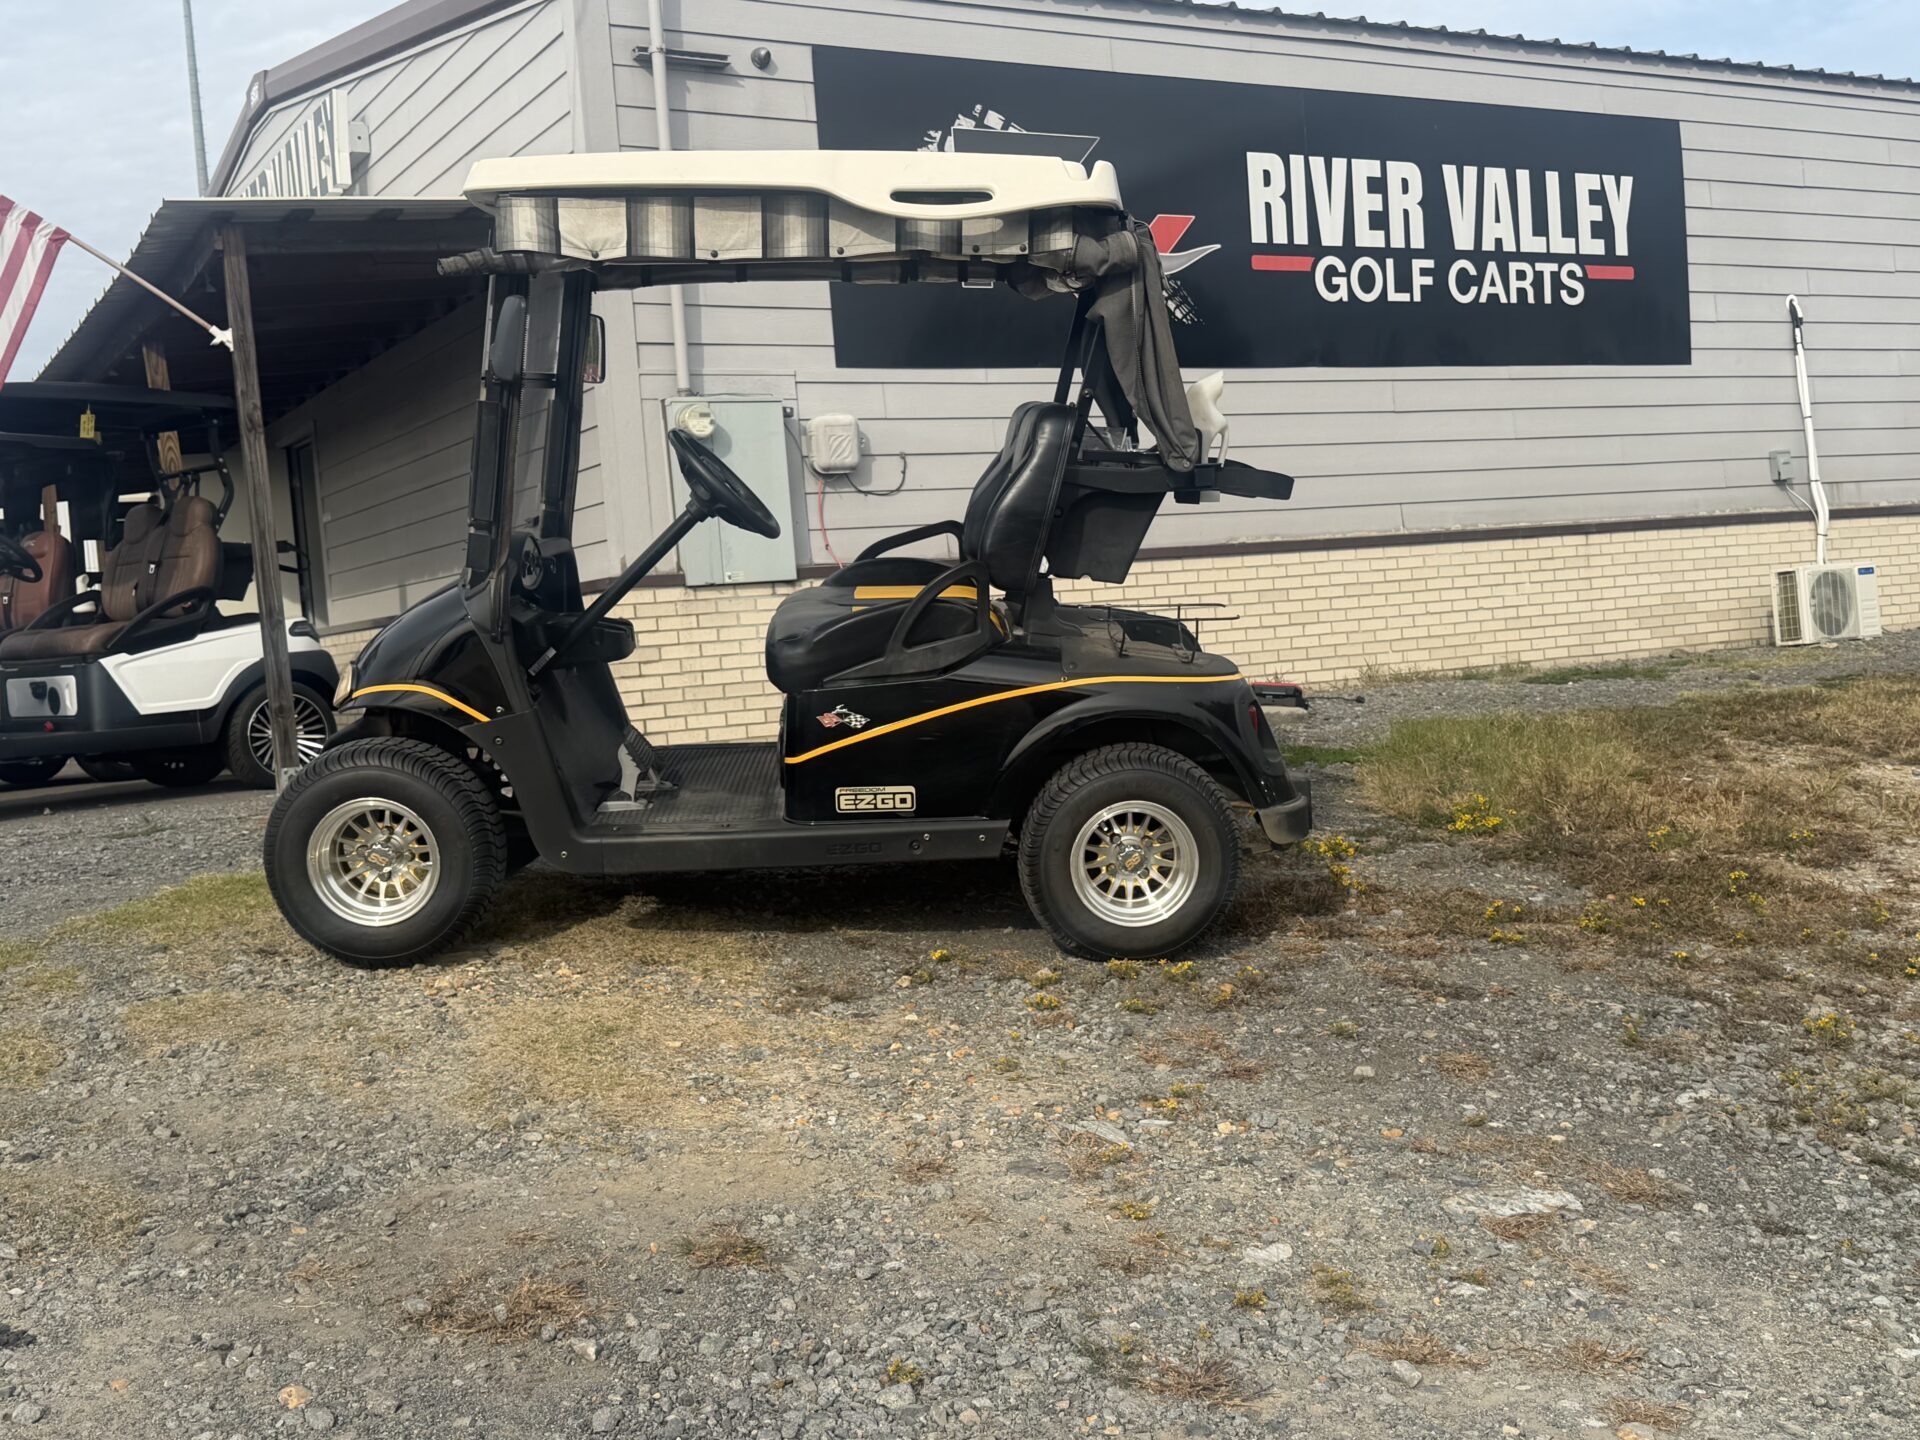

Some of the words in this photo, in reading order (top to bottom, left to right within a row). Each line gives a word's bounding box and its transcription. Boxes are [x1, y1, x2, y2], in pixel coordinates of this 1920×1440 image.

[1246, 151, 1425, 249] RIVER
[1441, 164, 1634, 257] VALLEY
[1314, 255, 1435, 303] GOLF
[1447, 259, 1585, 306] CARTS
[839, 793, 913, 810] EZGO
[828, 842, 882, 855] EZGO
